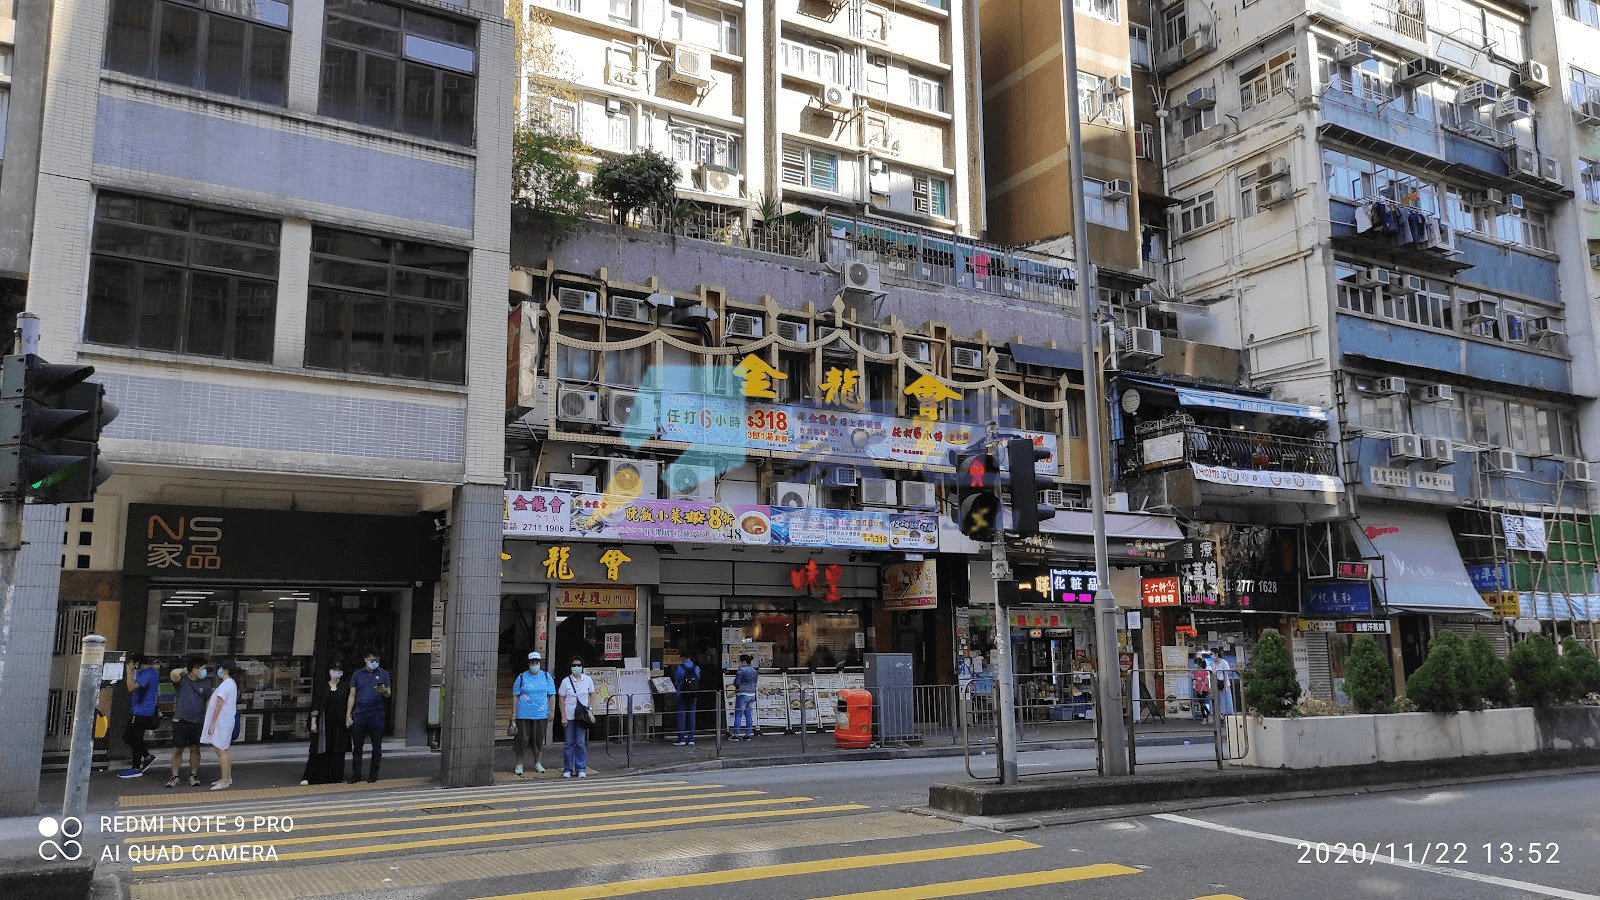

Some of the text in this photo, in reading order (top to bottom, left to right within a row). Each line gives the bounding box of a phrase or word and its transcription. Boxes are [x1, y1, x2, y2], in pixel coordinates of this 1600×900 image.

[733, 353, 963, 420] 金龍會
[666, 408, 741, 429] 任打6小時
[747, 409, 788, 431] $318
[512, 494, 565, 513] 金龍會
[147, 514, 224, 542] NS
[522, 523, 542, 531] 2711
[545, 524, 565, 533] 1908
[146, 542, 221, 570] 家品
[1236, 579, 1255, 593] 2777
[1258, 579, 1278, 593] 1628
